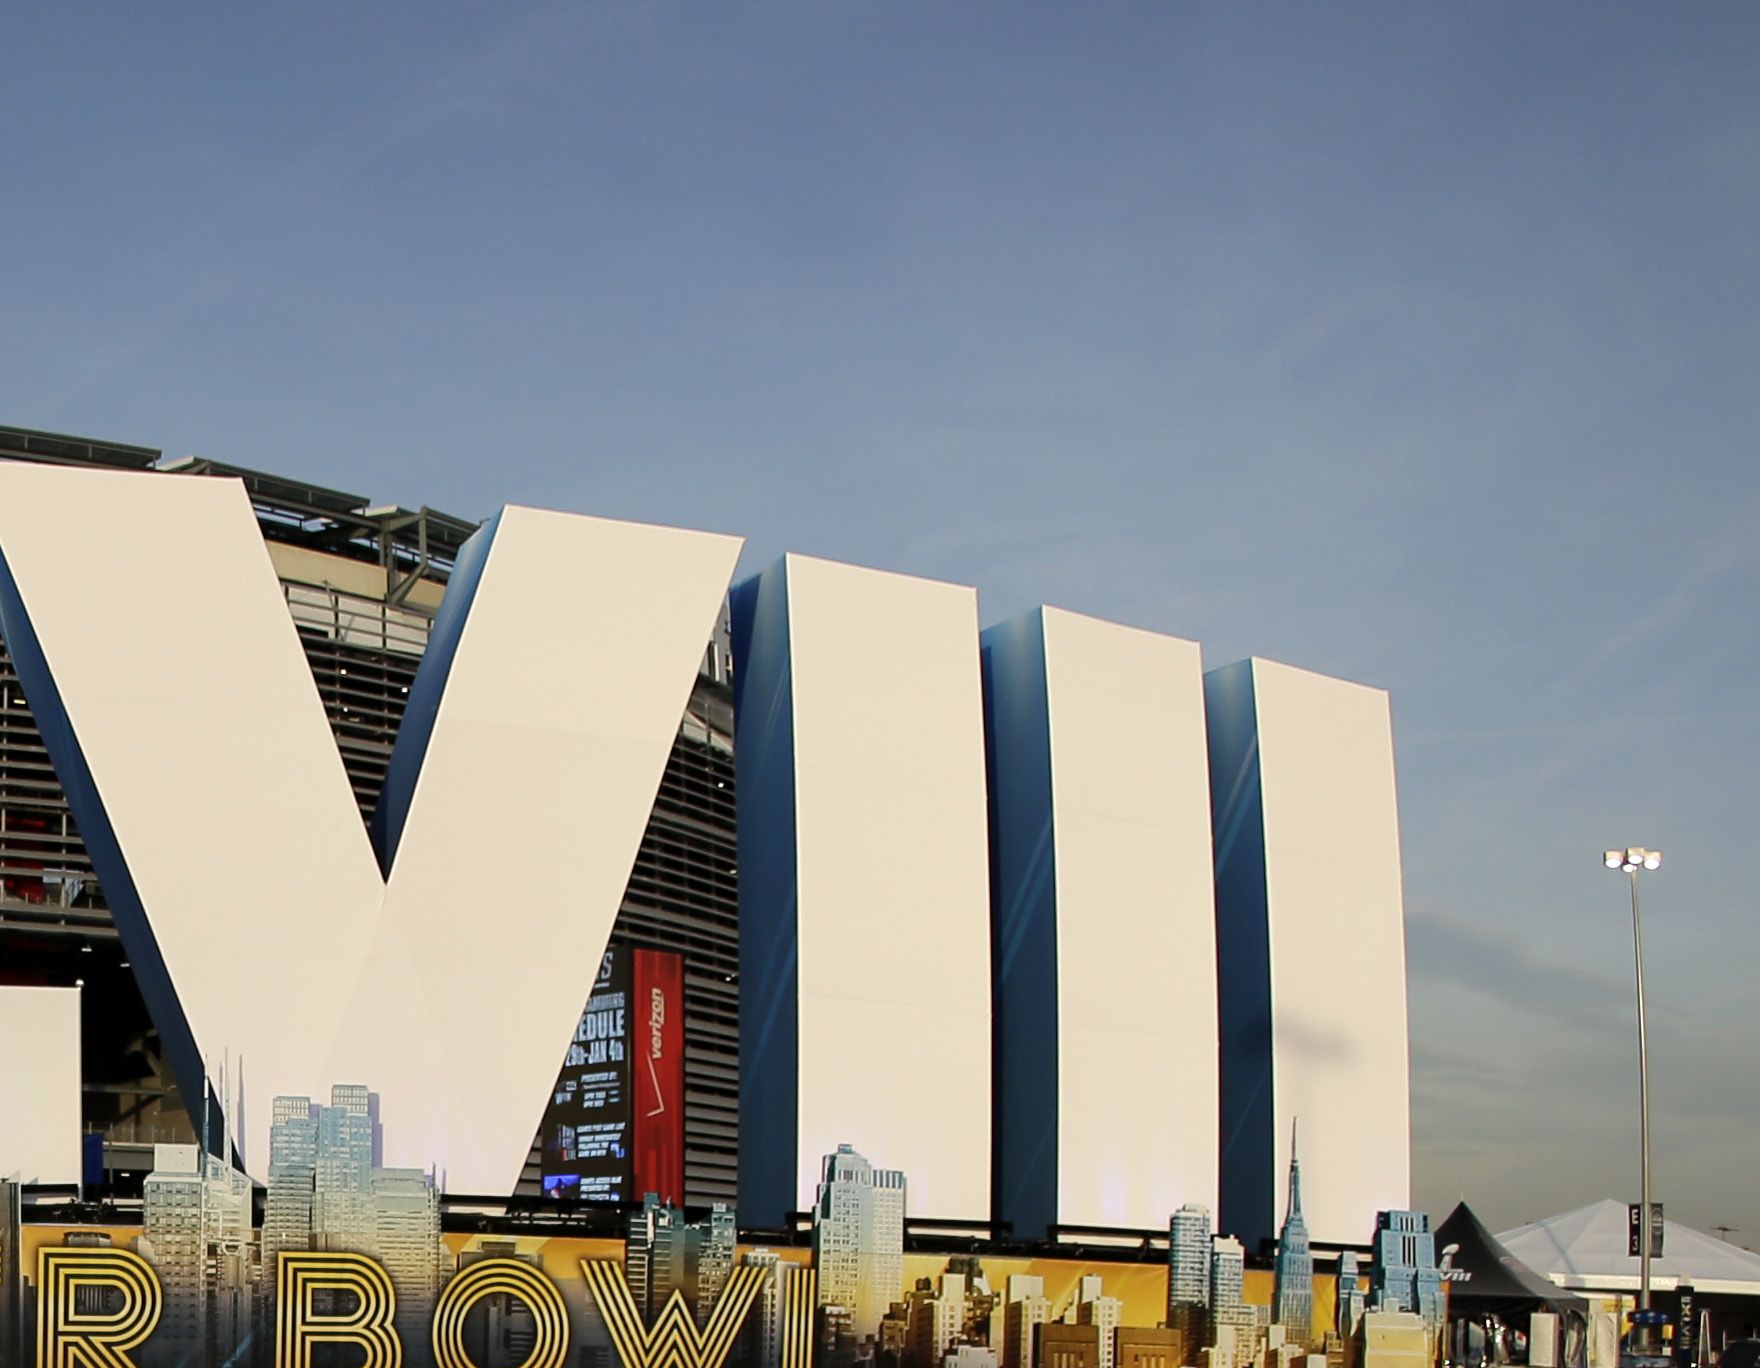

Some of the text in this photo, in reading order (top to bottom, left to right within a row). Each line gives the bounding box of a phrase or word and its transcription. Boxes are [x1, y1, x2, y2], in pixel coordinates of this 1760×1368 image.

[574, 1009, 625, 1042] EDULE
[649, 987, 665, 1059] verizon
[1440, 1272, 1472, 1281] VIII
